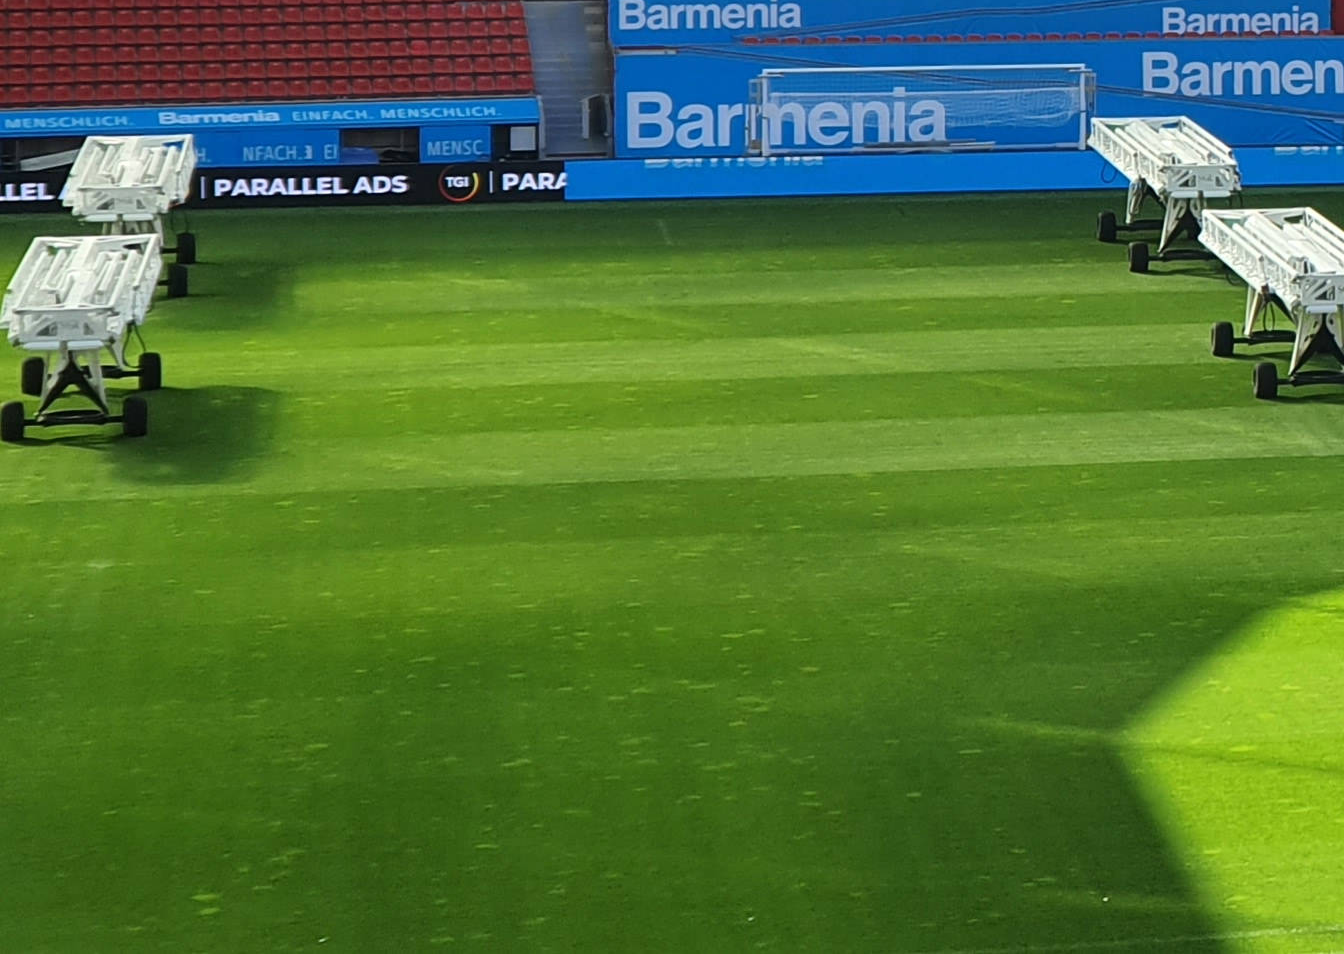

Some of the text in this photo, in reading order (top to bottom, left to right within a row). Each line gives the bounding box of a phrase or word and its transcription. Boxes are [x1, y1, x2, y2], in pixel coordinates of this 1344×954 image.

[1162, 6, 1321, 35] Barmenia
[157, 106, 502, 124] Barmenia EINFACH. MENSCHLICH.
[627, 87, 947, 148] Barmenia
[214, 175, 409, 197] PARALLEL ADS
[444, 176, 470, 188] TGI
